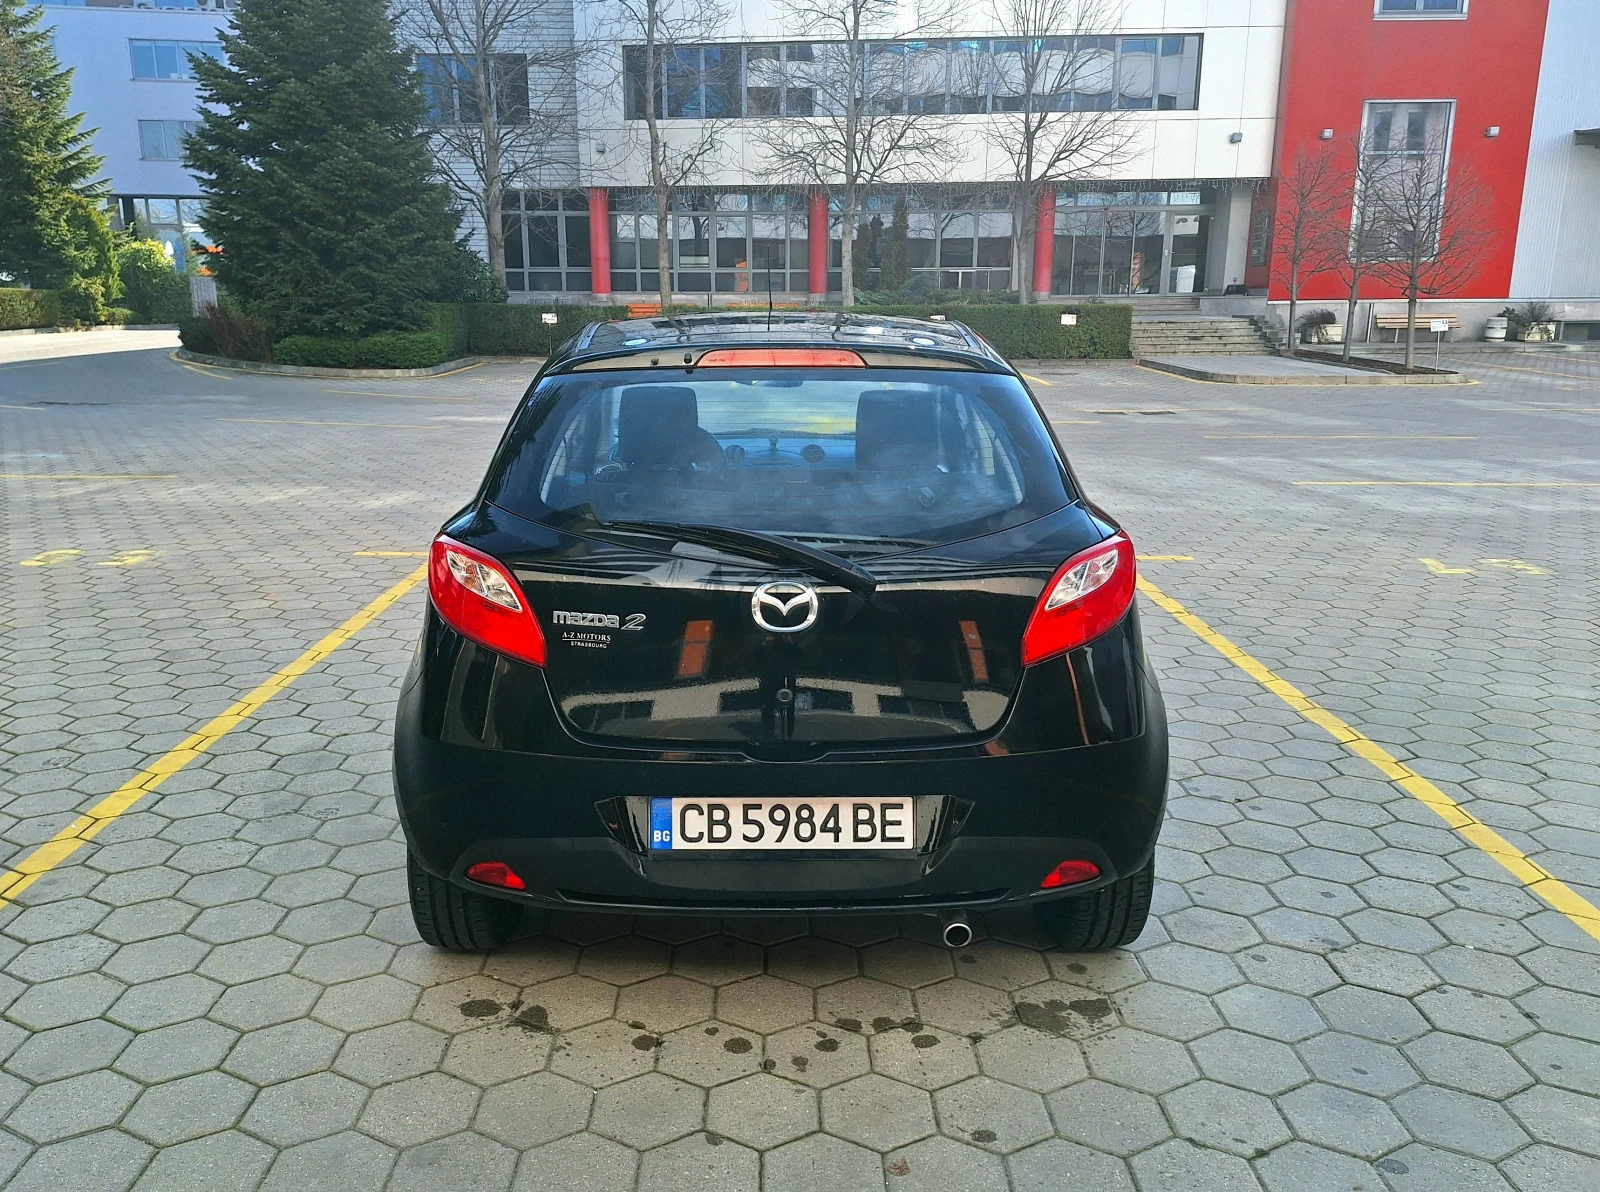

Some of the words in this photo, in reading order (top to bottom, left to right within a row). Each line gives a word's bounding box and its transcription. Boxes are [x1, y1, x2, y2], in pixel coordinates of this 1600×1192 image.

[621, 613, 646, 631] 2
[577, 633, 611, 641] MOTORS
[571, 641, 607, 649] STRASBOURG
[679, 803, 732, 843] CB
[742, 803, 842, 843] 5984
[852, 803, 905, 843] BE
[653, 831, 671, 842] BG
